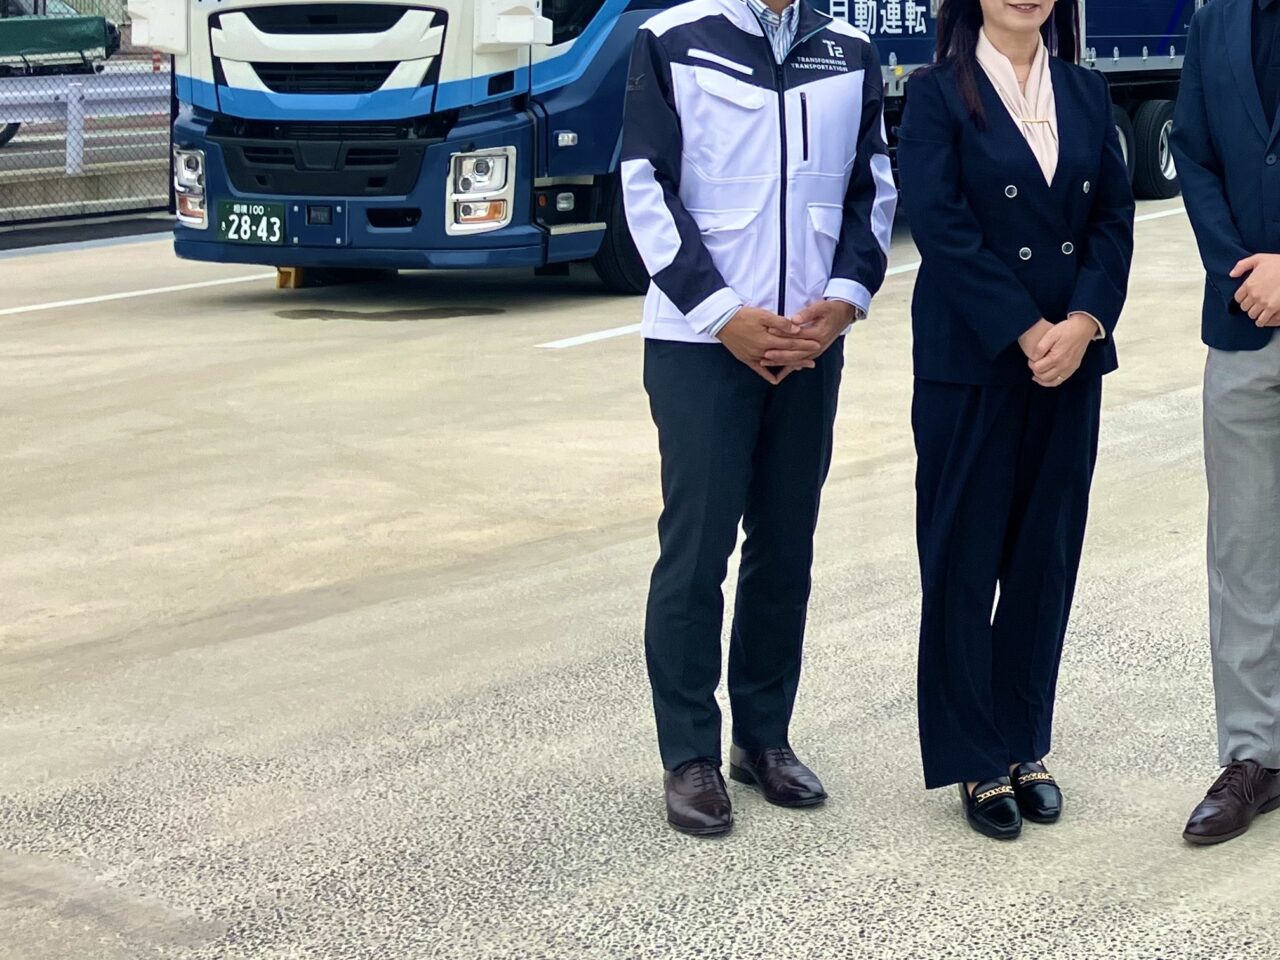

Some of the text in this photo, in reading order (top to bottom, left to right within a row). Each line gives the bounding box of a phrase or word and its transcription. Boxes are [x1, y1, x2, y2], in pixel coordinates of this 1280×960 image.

[822, 39, 844, 58] T2
[796, 56, 847, 66] TRANSFORMING
[791, 63, 849, 72] TRANSPORTATION
[249, 204, 265, 215] 100
[228, 214, 281, 242] 28-43
